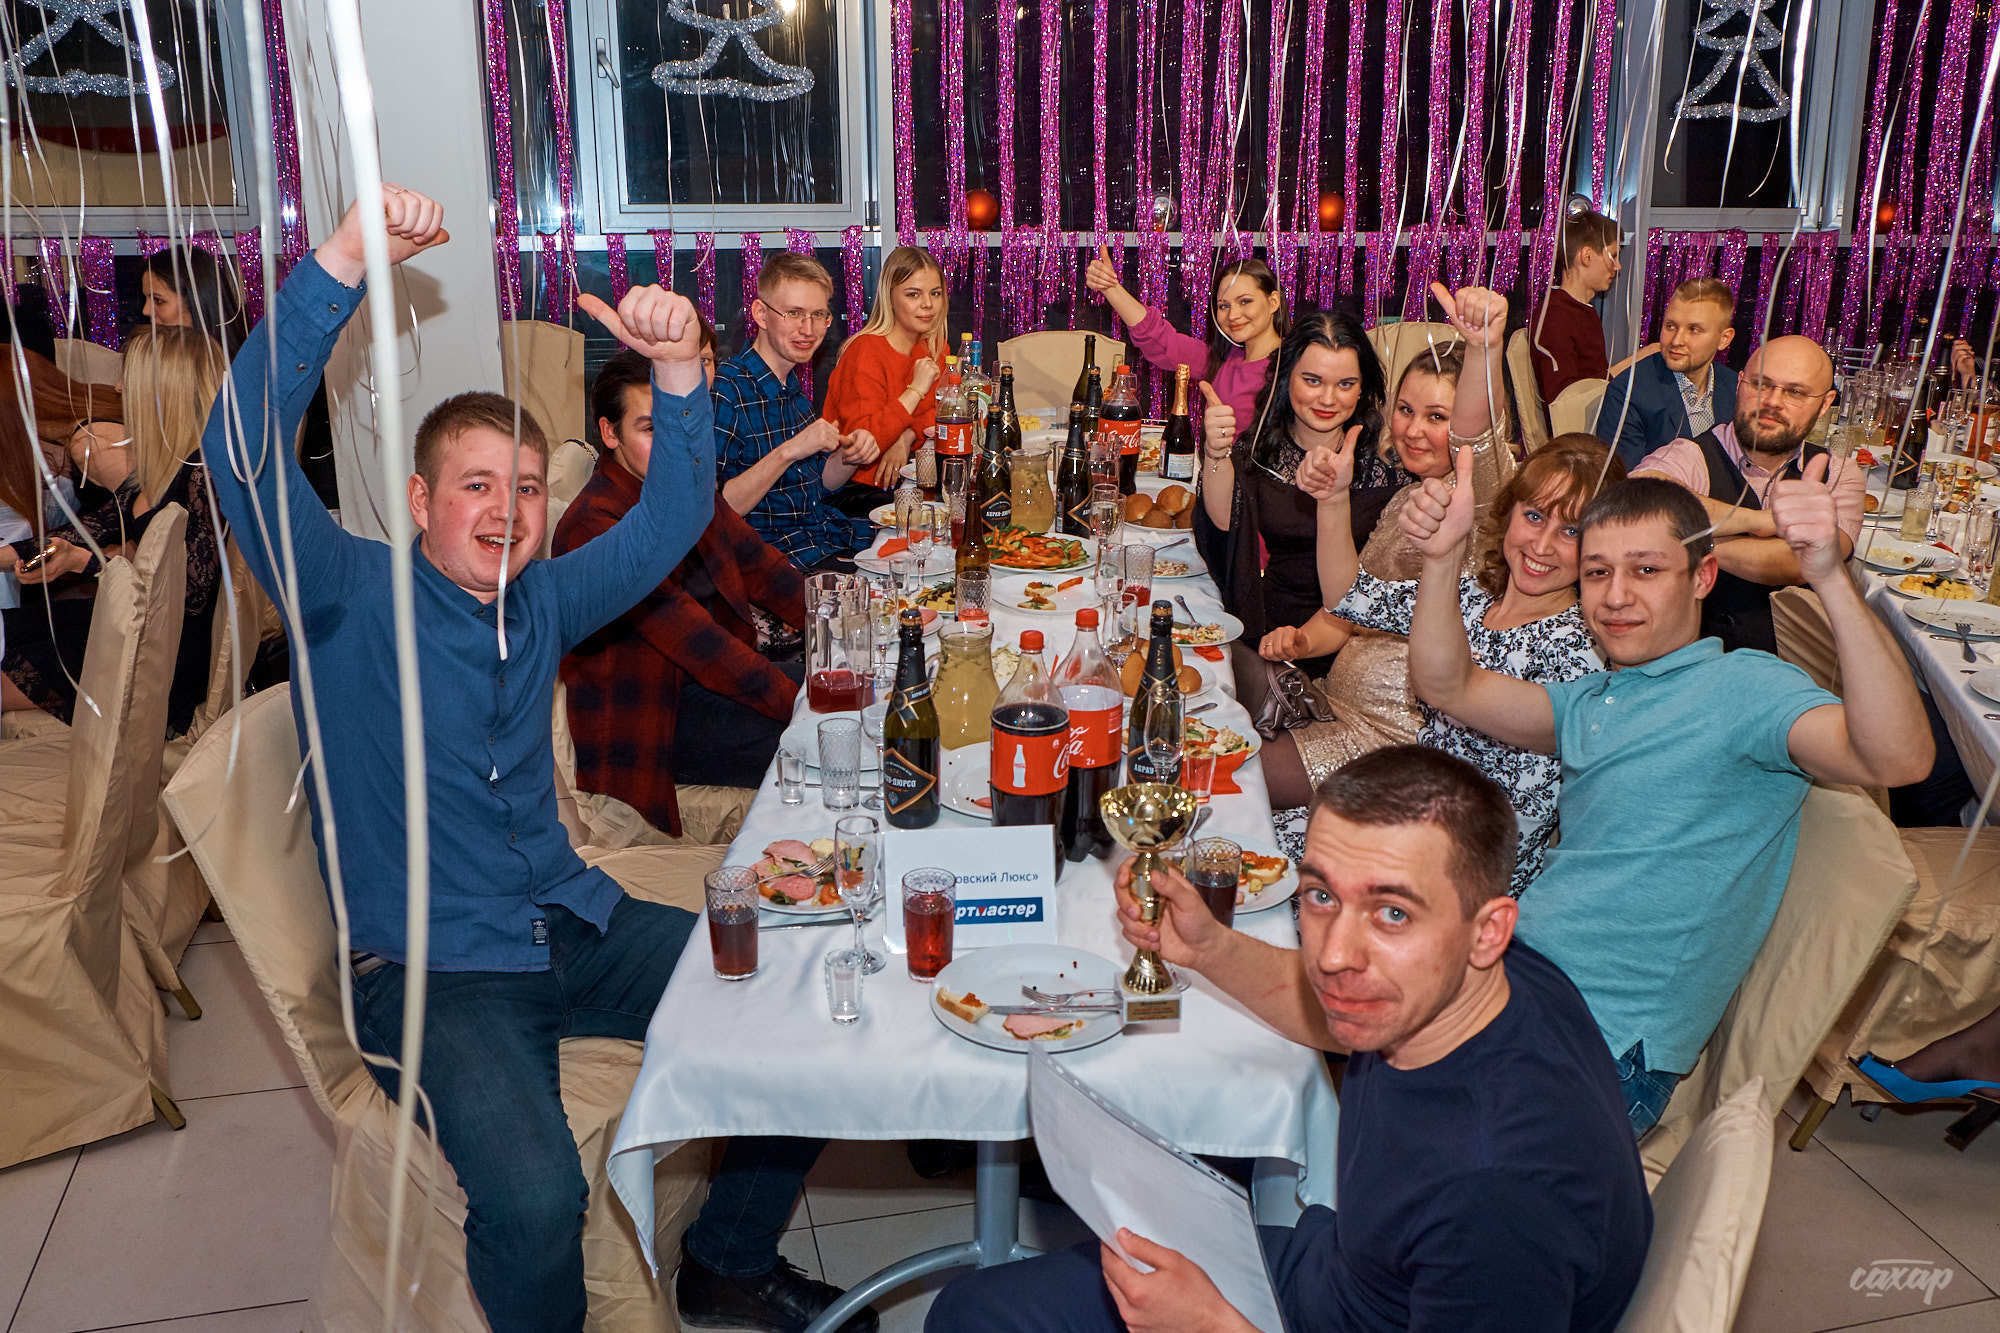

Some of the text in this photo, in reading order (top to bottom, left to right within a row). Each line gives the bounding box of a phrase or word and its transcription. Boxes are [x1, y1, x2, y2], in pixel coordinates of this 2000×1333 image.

[955, 871, 1039, 885] овский Люкс»
[954, 903, 1037, 921] ртмастер
